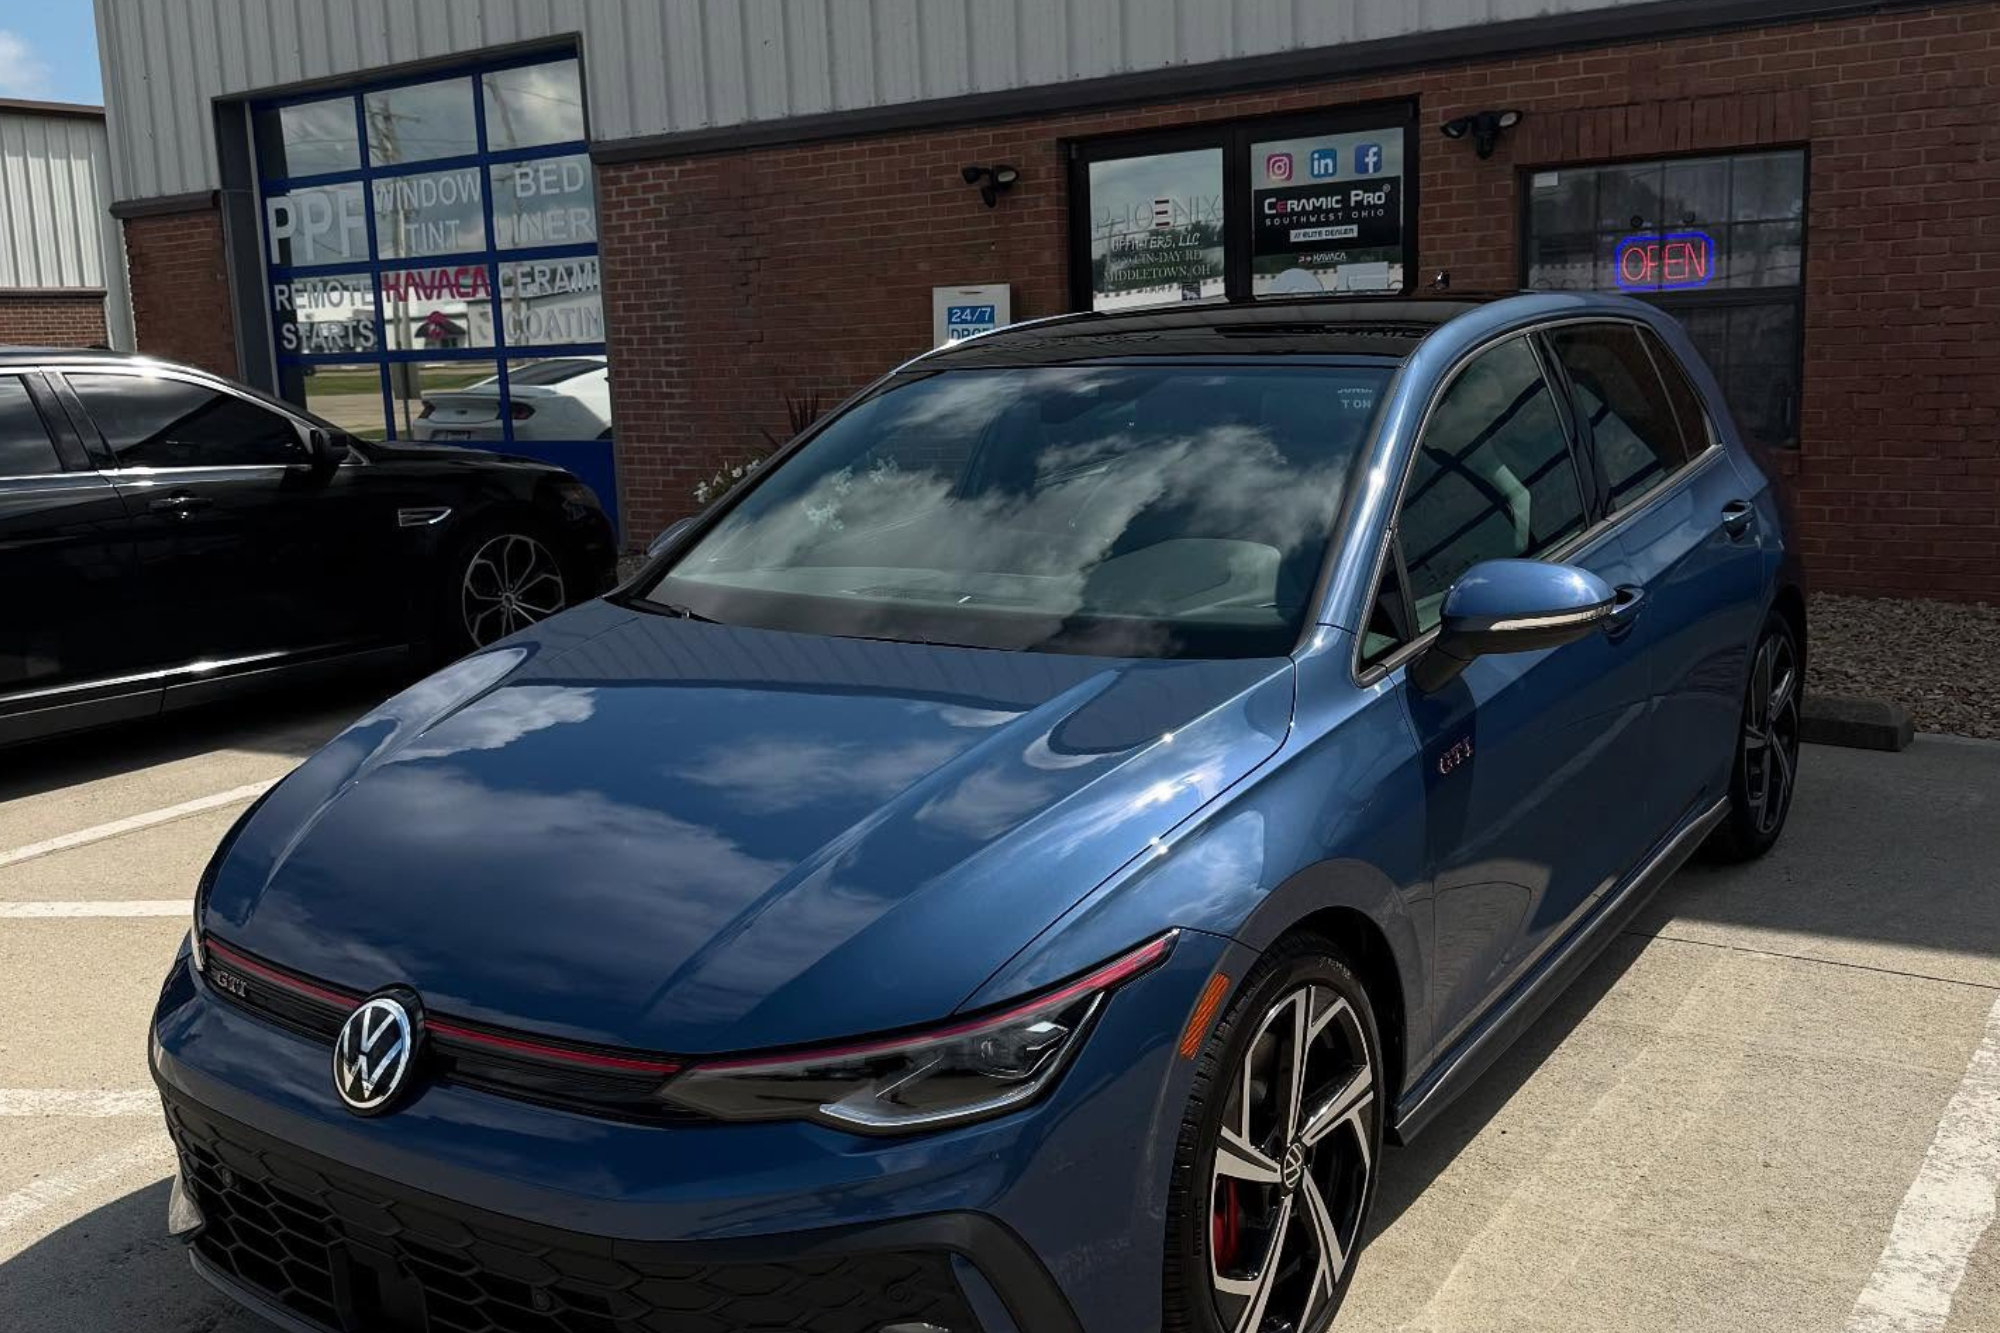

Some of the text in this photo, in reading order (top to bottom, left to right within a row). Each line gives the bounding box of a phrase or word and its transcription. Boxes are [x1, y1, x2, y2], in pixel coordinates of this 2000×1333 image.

[373, 171, 480, 214] WINDOW
[514, 161, 584, 198] BED
[1095, 195, 1221, 232] PHOENIX
[1264, 195, 1343, 214] CERAMIC
[1265, 208, 1385, 226] SOUTHWEST OHIO
[267, 189, 365, 264] PPF
[407, 219, 460, 252] TINT
[1178, 232, 1201, 247] LLC
[1324, 227, 1355, 237] DEALER
[1185, 249, 1203, 261] RD
[1192, 264, 1211, 276] OH
[1622, 241, 1705, 282] OPEN
[274, 279, 374, 311] REMOTE
[382, 266, 492, 302] KAVACA
[951, 306, 991, 322] 24/7
[282, 318, 374, 349] STARTS
[1439, 736, 1473, 775] GTI
[215, 970, 248, 998] GTI
